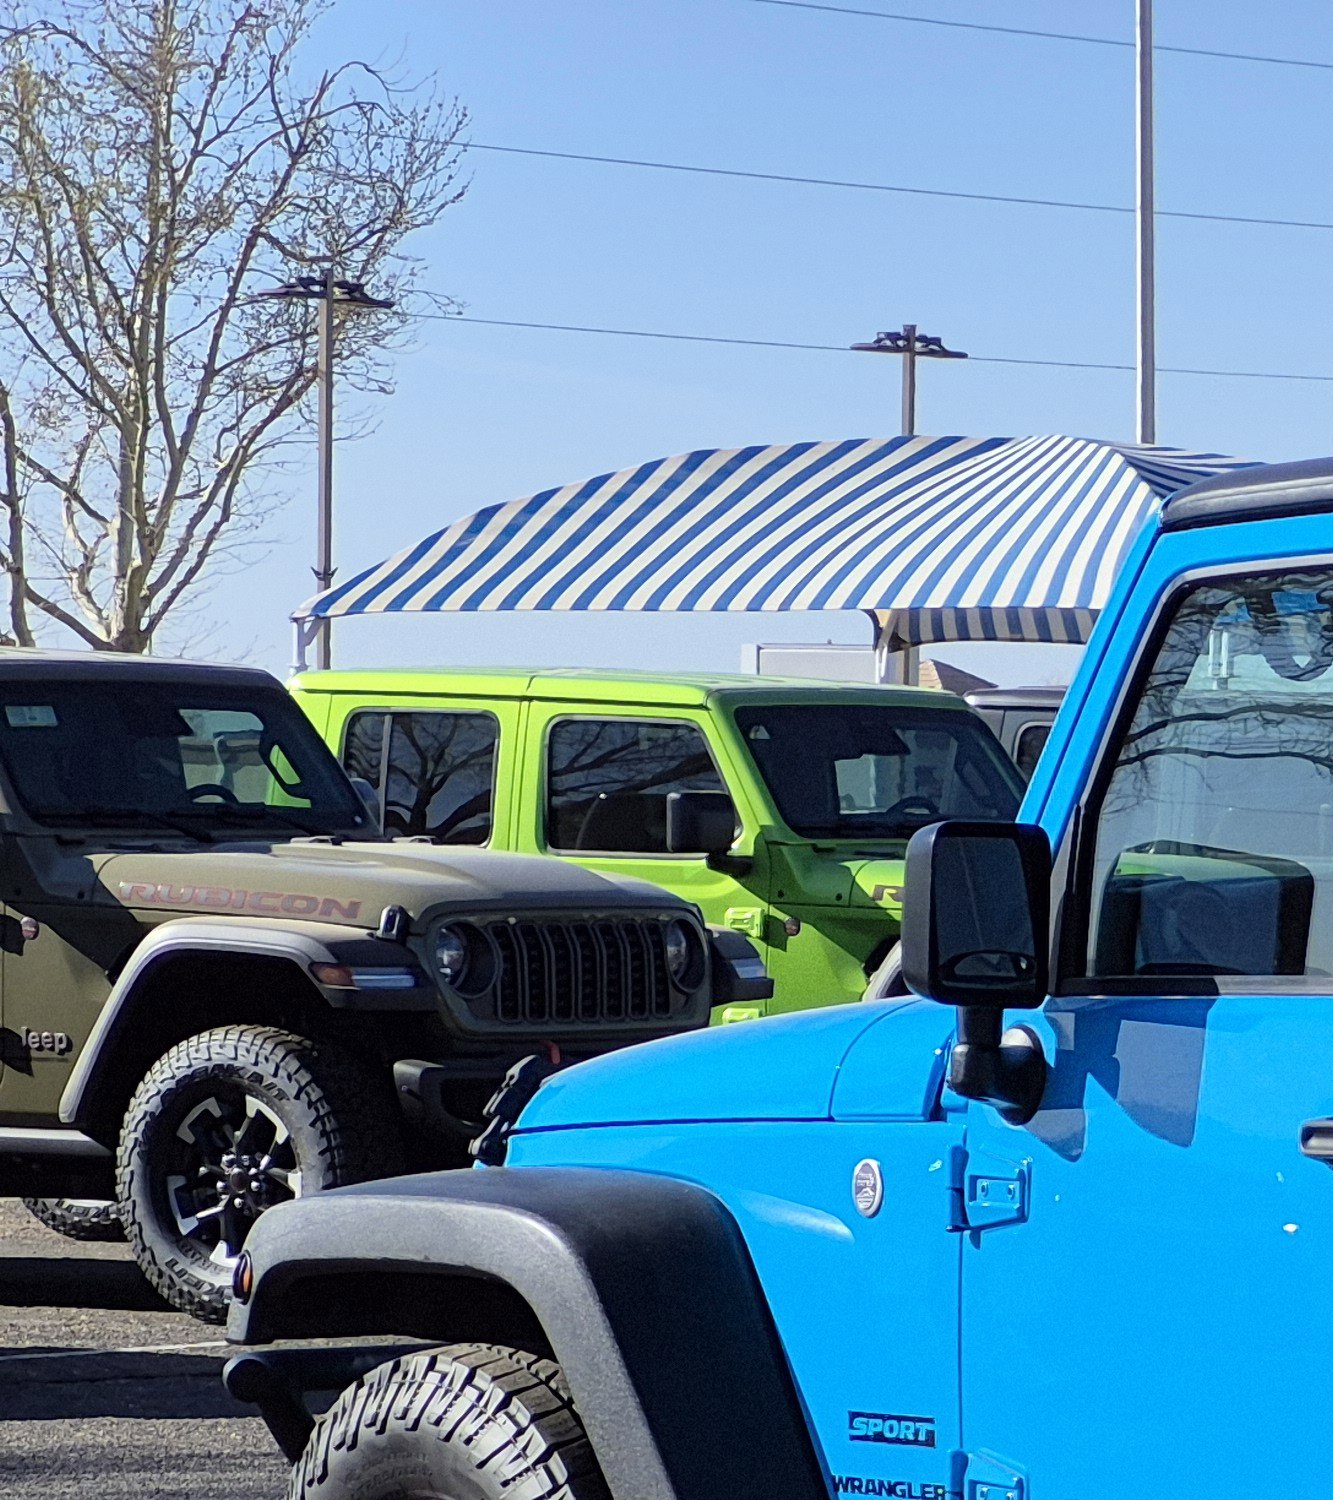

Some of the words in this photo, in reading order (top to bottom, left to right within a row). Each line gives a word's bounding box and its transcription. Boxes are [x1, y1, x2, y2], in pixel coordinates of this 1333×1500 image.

[118, 880, 363, 919] RUBICON
[20, 1026, 67, 1054] Jeep
[850, 1415, 932, 1443] SPORT
